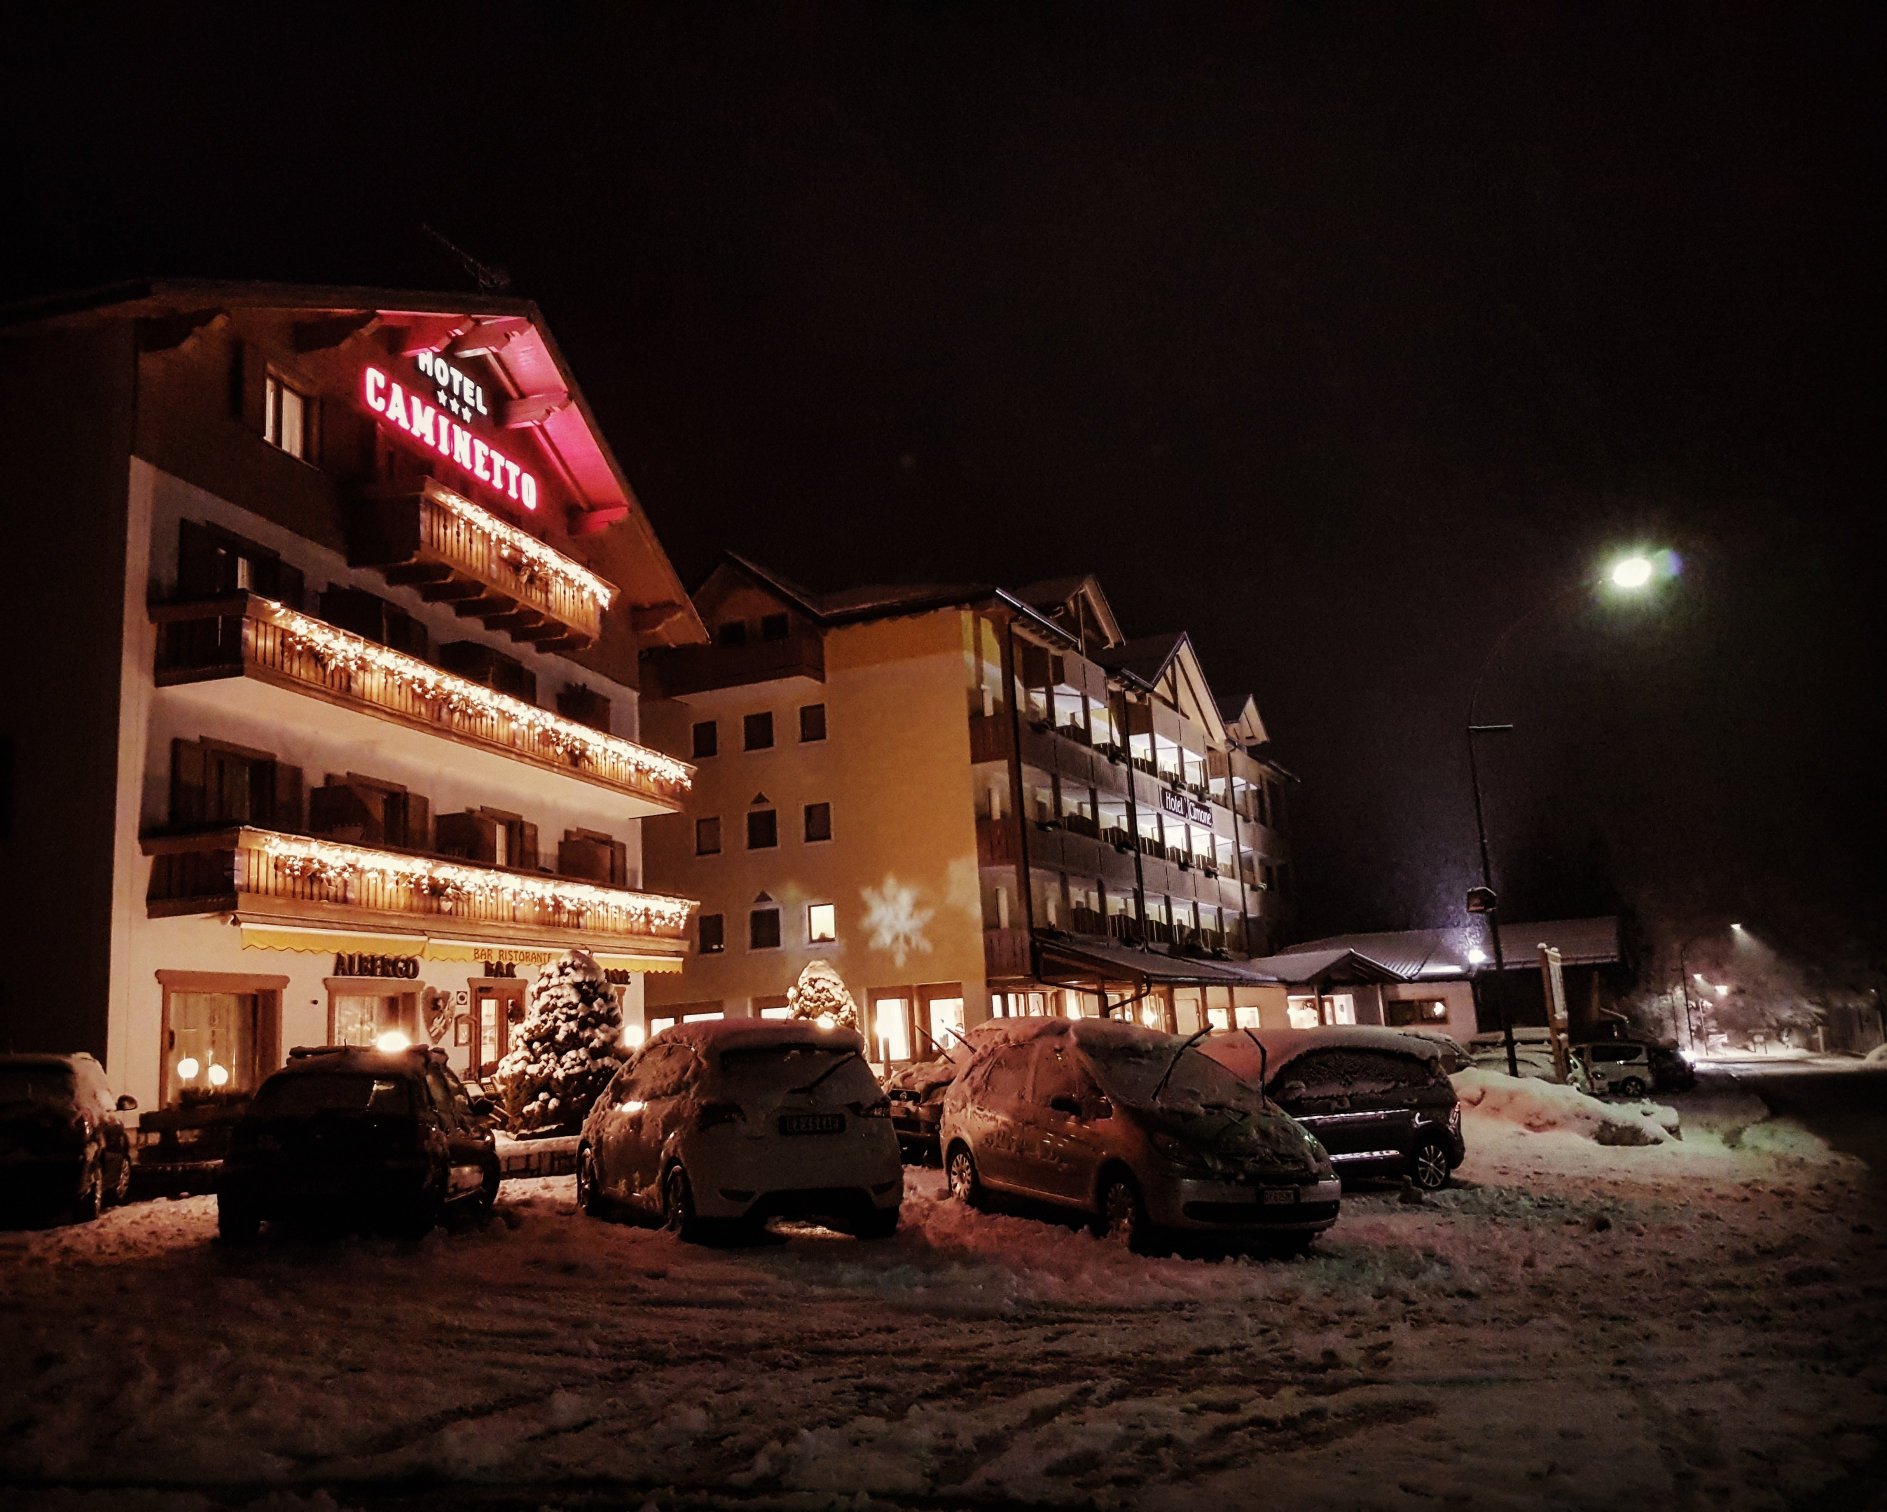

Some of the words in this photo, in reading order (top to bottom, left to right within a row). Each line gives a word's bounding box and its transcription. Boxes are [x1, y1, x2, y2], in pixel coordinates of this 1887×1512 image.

[418, 351, 488, 415] HOTEL
[366, 367, 537, 510] CAMINETTO
[1165, 791, 1184, 815] Hotel
[333, 951, 420, 979] ALBERGO
[473, 948, 493, 961] BAR
